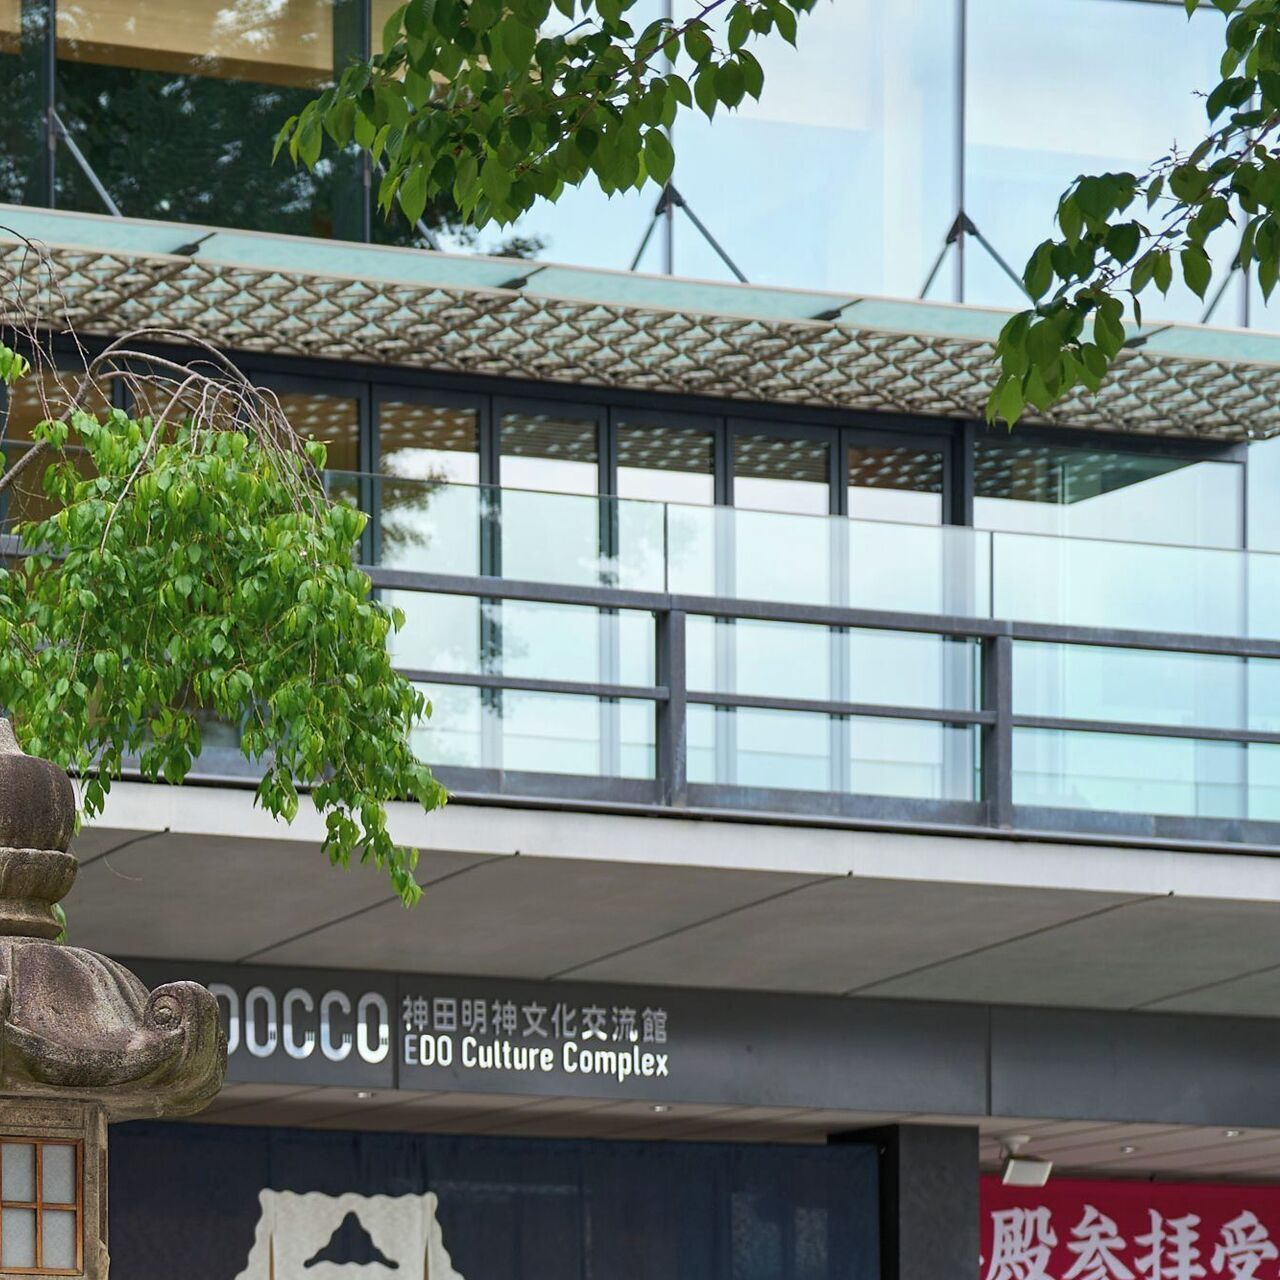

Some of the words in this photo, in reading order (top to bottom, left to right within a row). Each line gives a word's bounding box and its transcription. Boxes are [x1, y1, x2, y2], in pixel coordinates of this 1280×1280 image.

[208, 983, 389, 1064] DOCCO
[402, 995, 668, 1044] 神田明神文化交流館
[404, 1034, 453, 1067] EDO
[462, 1036, 554, 1072] Culture
[563, 1041, 669, 1082] Complex
